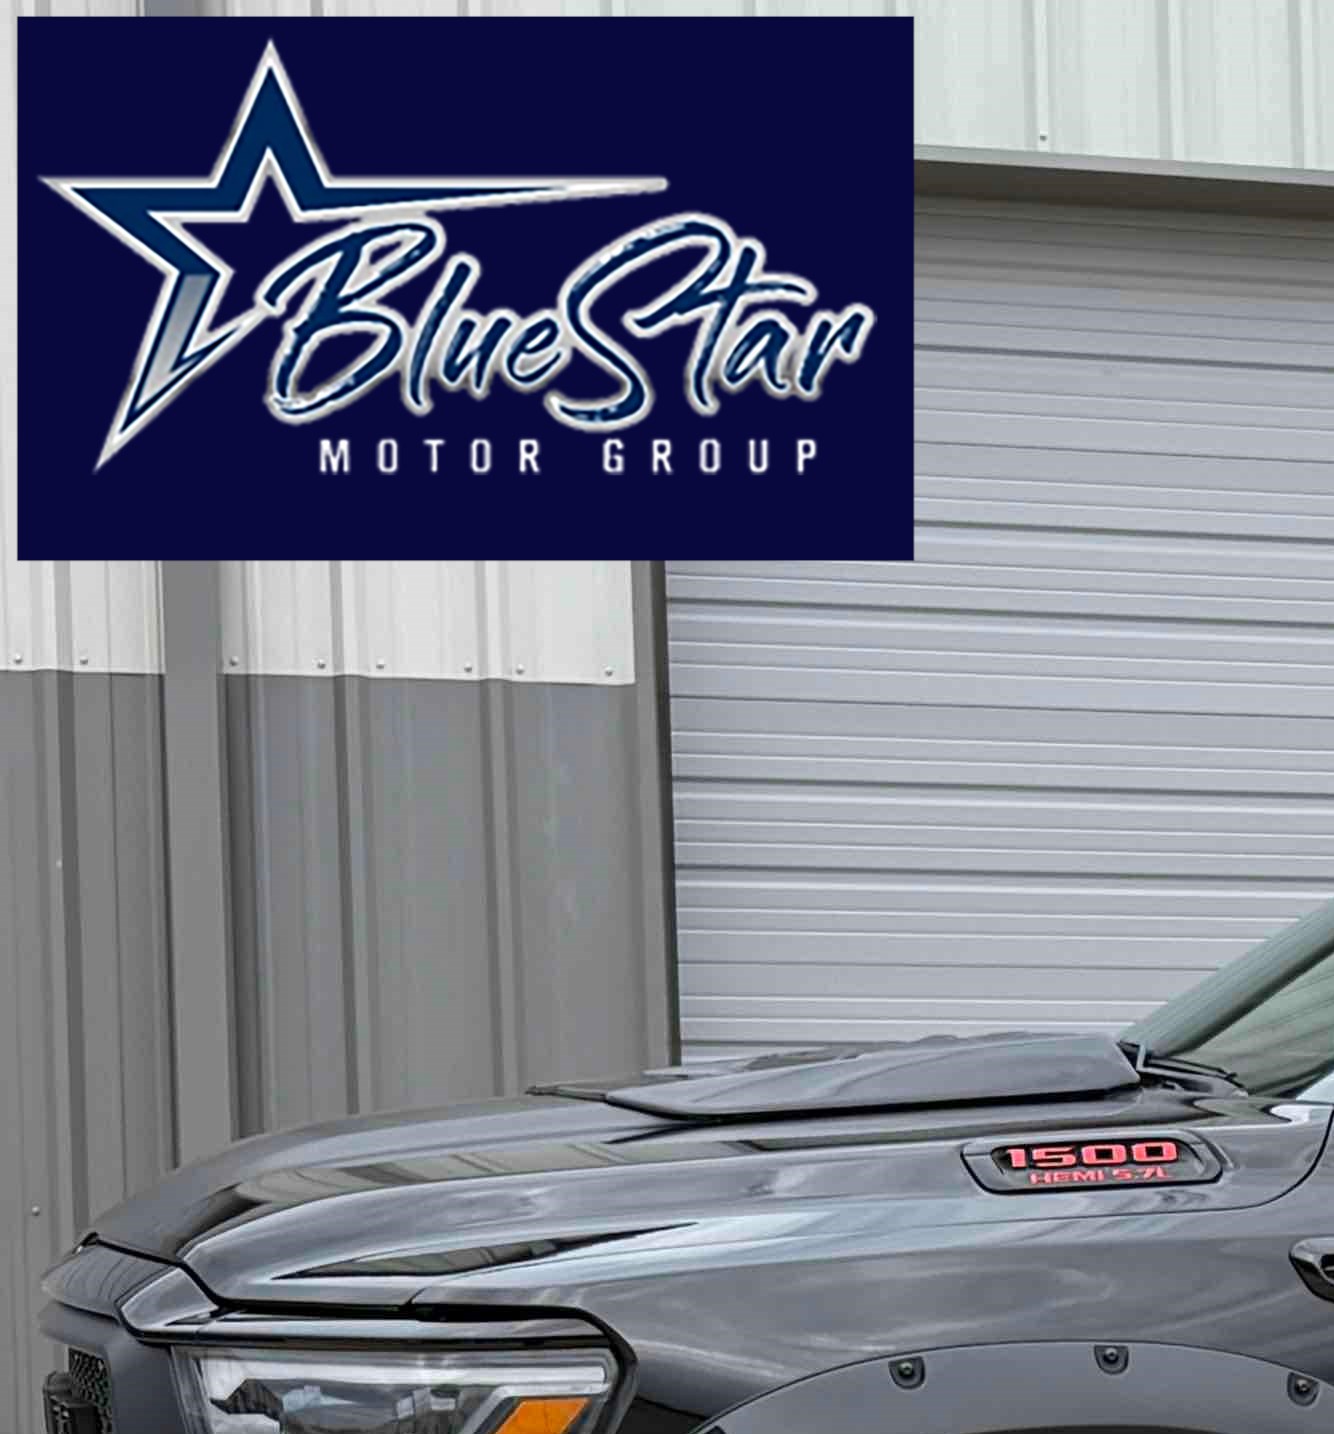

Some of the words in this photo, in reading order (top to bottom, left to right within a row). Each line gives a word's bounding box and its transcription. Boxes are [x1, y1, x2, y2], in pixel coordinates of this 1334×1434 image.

[1006, 1140, 1179, 1169] 1500
[1029, 1169, 1105, 1184] HEMI
[1112, 1165, 1172, 1181] 5.7L
